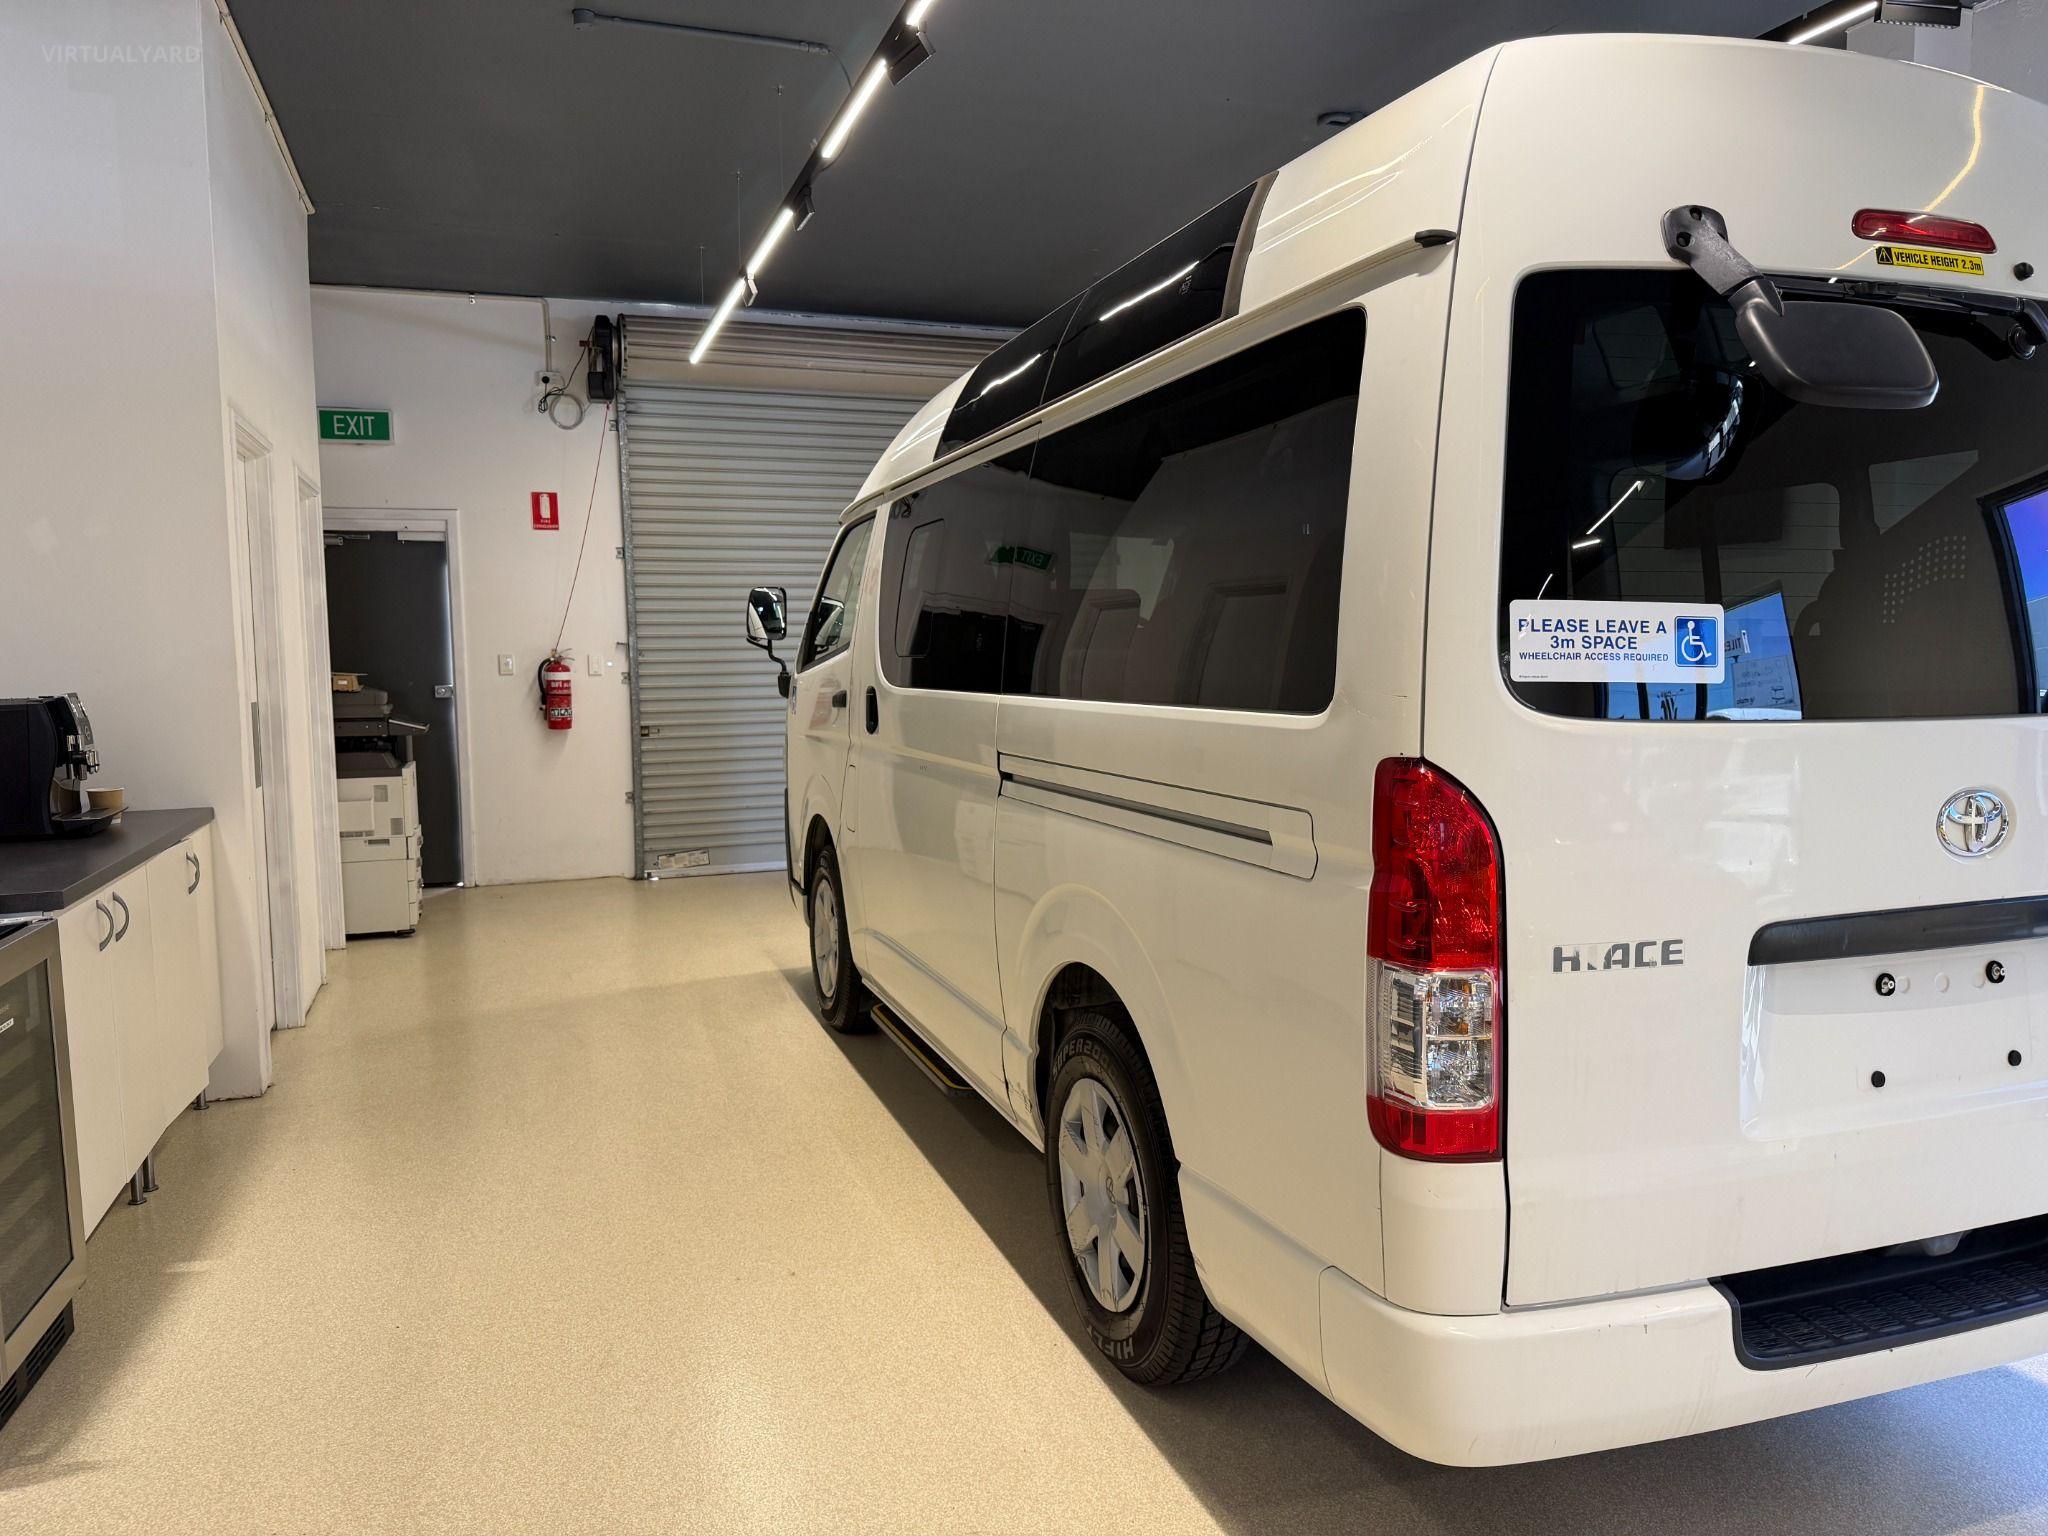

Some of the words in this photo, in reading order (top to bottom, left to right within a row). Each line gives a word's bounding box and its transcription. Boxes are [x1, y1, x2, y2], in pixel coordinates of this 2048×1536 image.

[1894, 251, 1929, 265] VEHICLE
[1930, 254, 1959, 268] HEIGHT
[1961, 259, 1982, 271] 2.3m
[333, 415, 375, 436] EXIT
[1518, 618, 1589, 634] PLEASE
[1595, 619, 1650, 634] LEAVE
[1656, 621, 1667, 634] A
[1550, 636, 1575, 649] 3m
[1581, 636, 1638, 650] SPACE
[1519, 651, 1582, 662] WHEELCHAIR
[1584, 652, 1621, 662] ACCESS
[1623, 652, 1669, 663] REQUIRED
[1552, 939, 1684, 972] HACE
